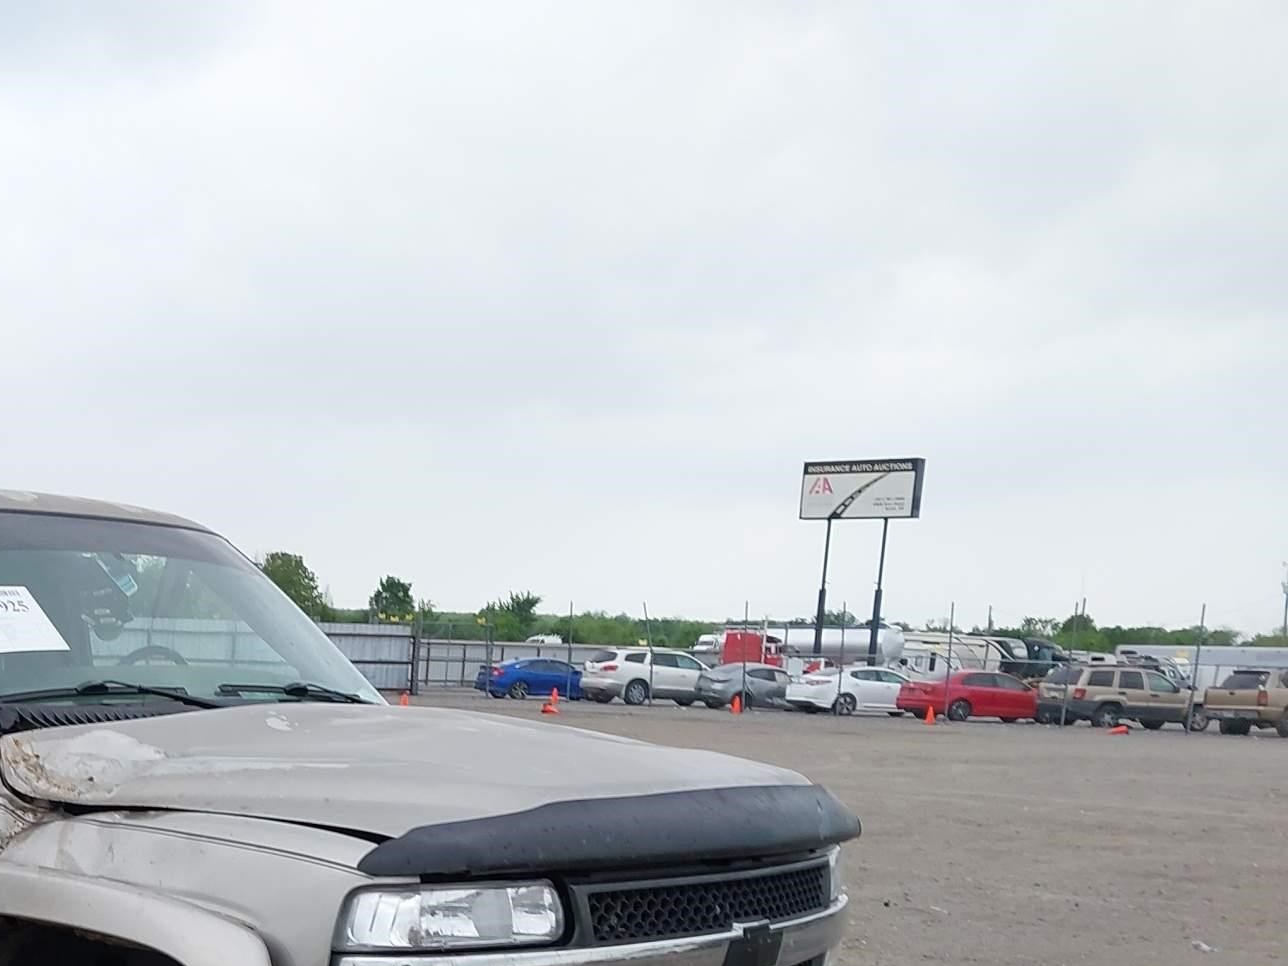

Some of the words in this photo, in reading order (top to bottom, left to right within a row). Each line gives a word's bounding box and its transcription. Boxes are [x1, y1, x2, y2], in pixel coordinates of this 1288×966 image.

[808, 464, 850, 473] INSURANCE
[851, 463, 873, 472] AUTO
[873, 462, 913, 471] AUCTIONS
